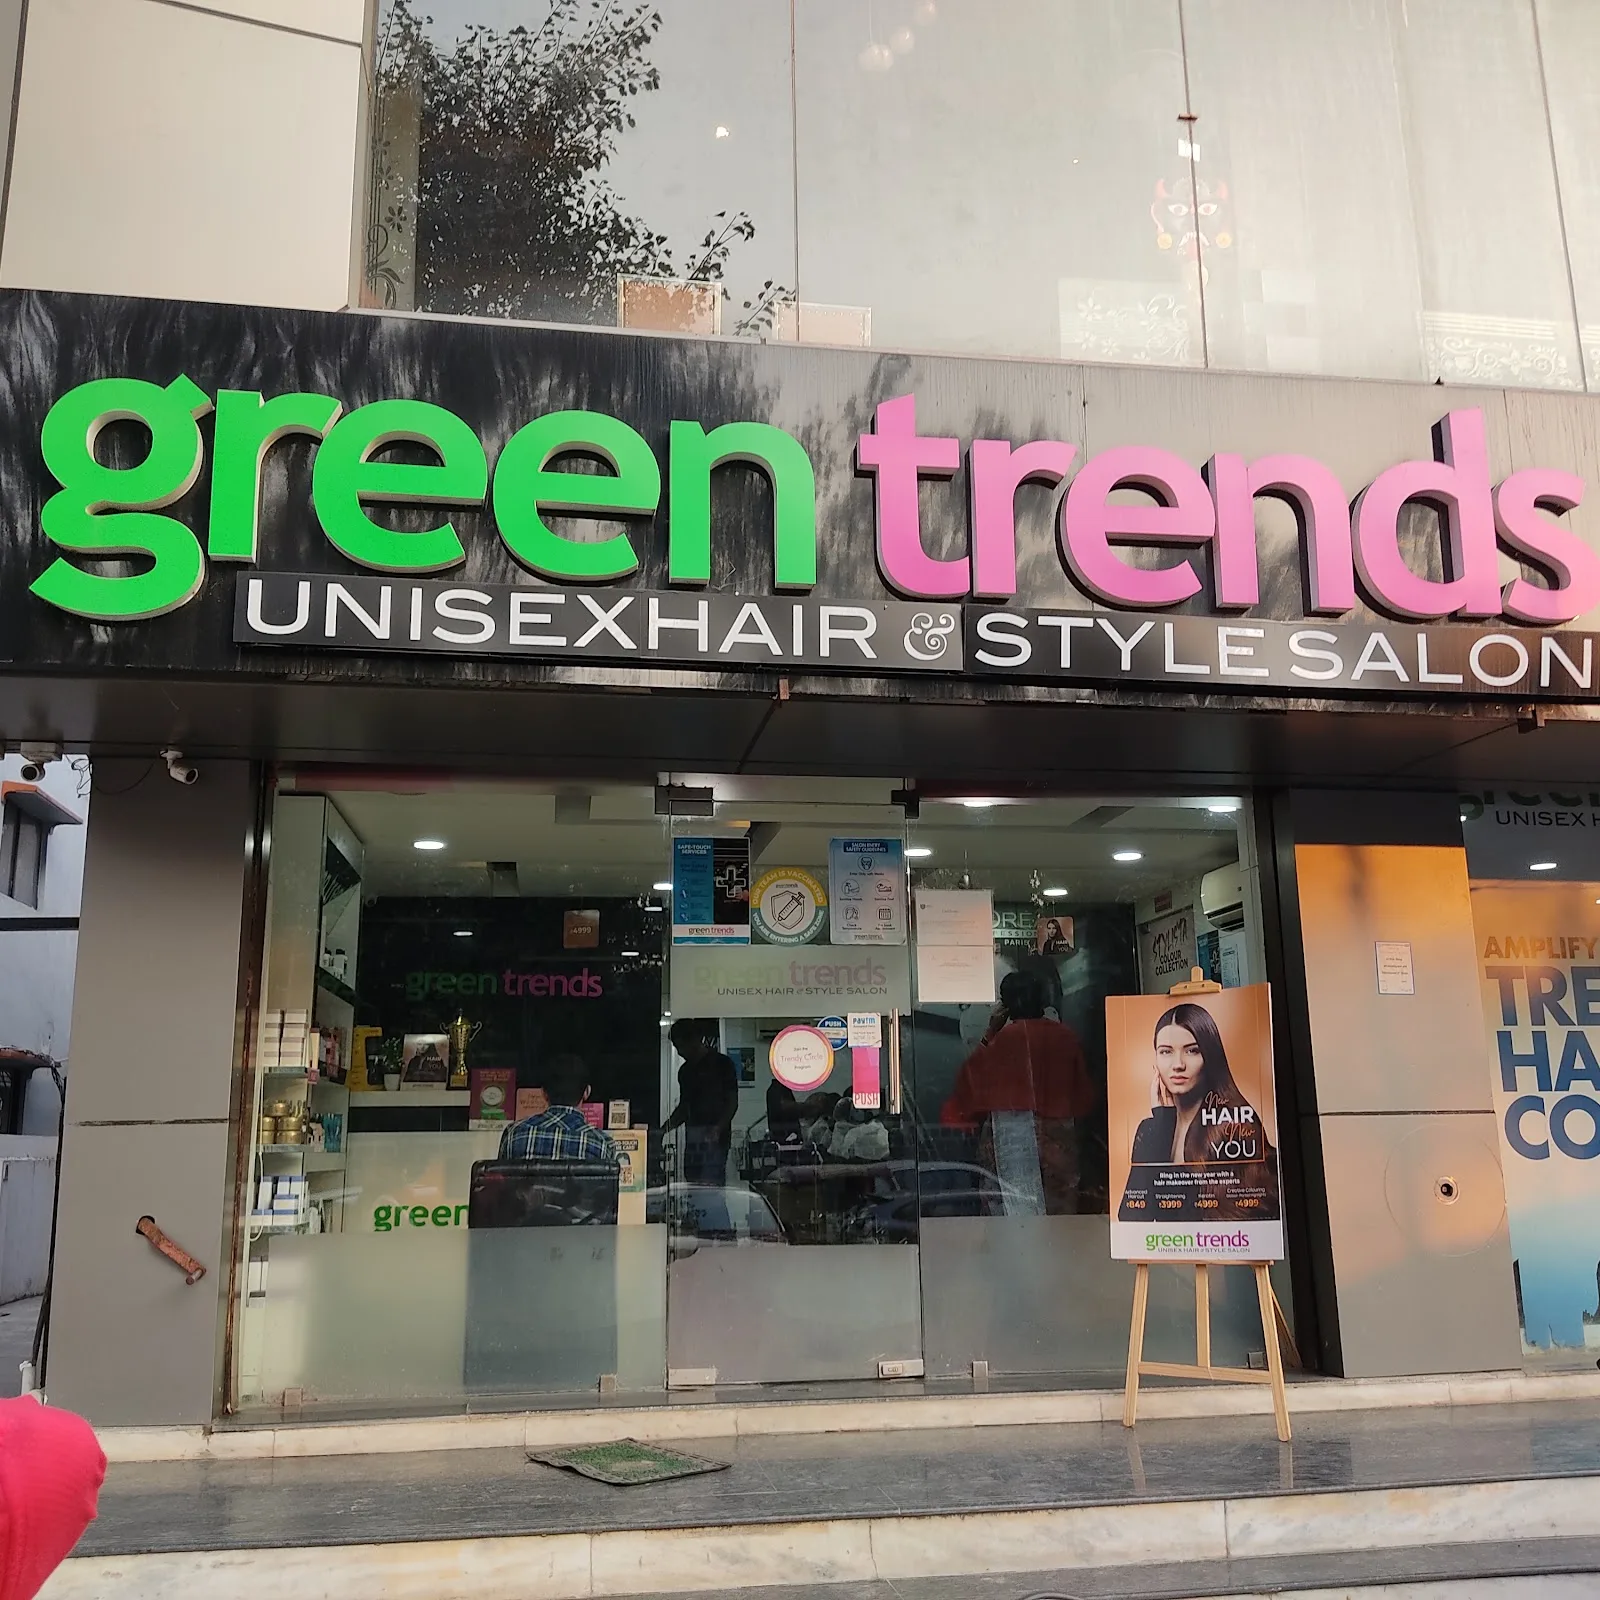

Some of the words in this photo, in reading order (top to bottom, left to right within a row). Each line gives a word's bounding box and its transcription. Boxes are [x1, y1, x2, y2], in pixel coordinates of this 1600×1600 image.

[29, 373, 816, 621] green
[855, 392, 1600, 624] trends
[903, 610, 957, 662] &
[974, 613, 1271, 678] STYLE
[1287, 631, 1593, 690] SALON
[1495, 811, 1586, 827] UNISEX
[760, 873, 778, 889] TEAM
[688, 927, 710, 936] green
[710, 926, 735, 935] trends
[1160, 950, 1182, 965] COLOUR
[1484, 936, 1598, 960] AMPLIFY
[789, 957, 887, 986] trends
[1156, 958, 1189, 976] COLLECTION
[405, 970, 498, 1001] green
[503, 967, 603, 998] trends
[717, 987, 762, 996] UNISEX
[765, 987, 794, 995] HAIR
[805, 987, 842, 995] STYLE
[847, 986, 888, 995] SALON
[780, 1055, 802, 1063] Trendy
[804, 1053, 823, 1061] Circle
[854, 1092, 880, 1106] PUSH
[1205, 1091, 1229, 1112] New
[1201, 1105, 1255, 1126] HAIR
[1225, 1121, 1256, 1145] New
[1504, 1094, 1600, 1161] CO
[1211, 1139, 1256, 1159] YOU
[1219, 1178, 1240, 1186] experts
[374, 1203, 469, 1232] green
[1146, 1233, 1194, 1251] green
[1196, 1230, 1249, 1247] trends
